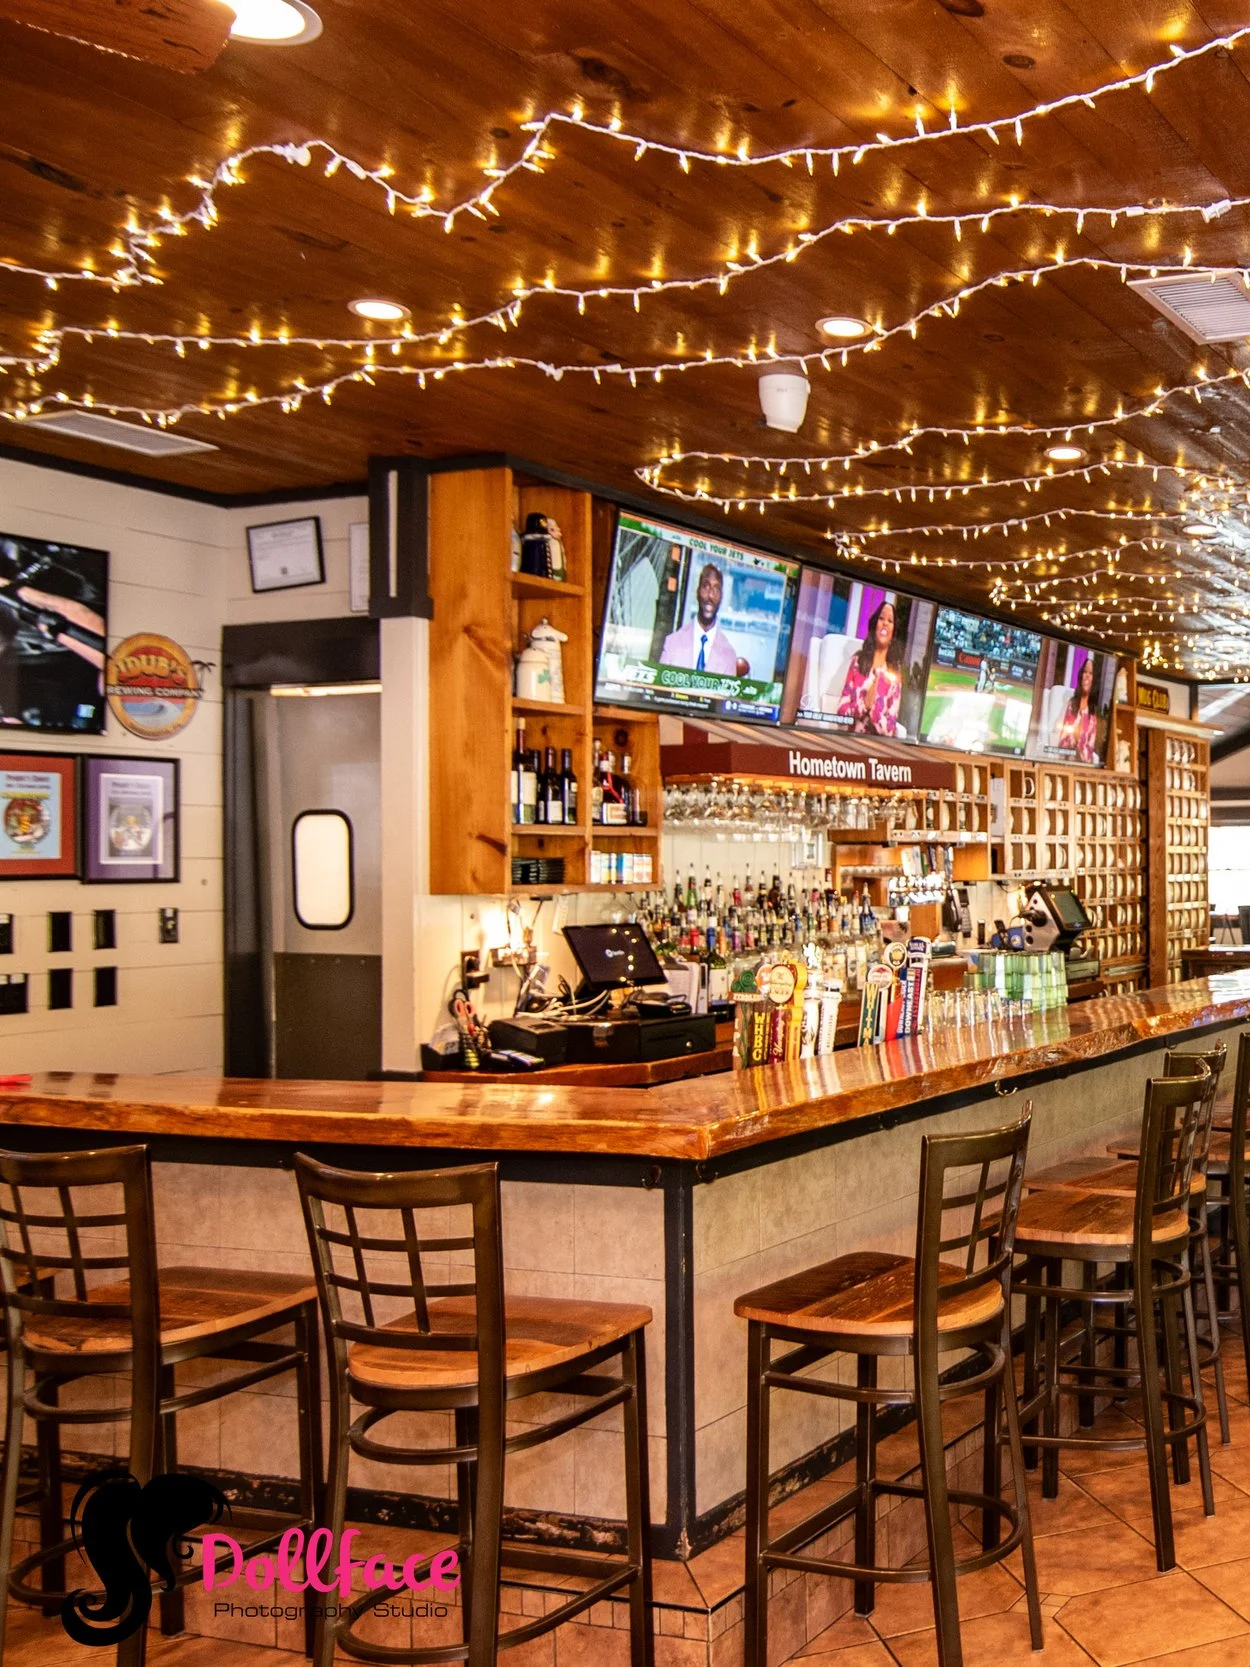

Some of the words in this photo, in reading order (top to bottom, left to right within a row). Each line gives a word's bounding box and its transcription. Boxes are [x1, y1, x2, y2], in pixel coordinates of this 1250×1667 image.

[689, 537, 708, 550] COOL
[709, 543, 728, 556] YOUR
[728, 548, 744, 561] JETS
[660, 670, 691, 687] COOL
[690, 675, 720, 690] YOUR
[788, 750, 866, 780] Hometown
[868, 757, 912, 783] Tavern
